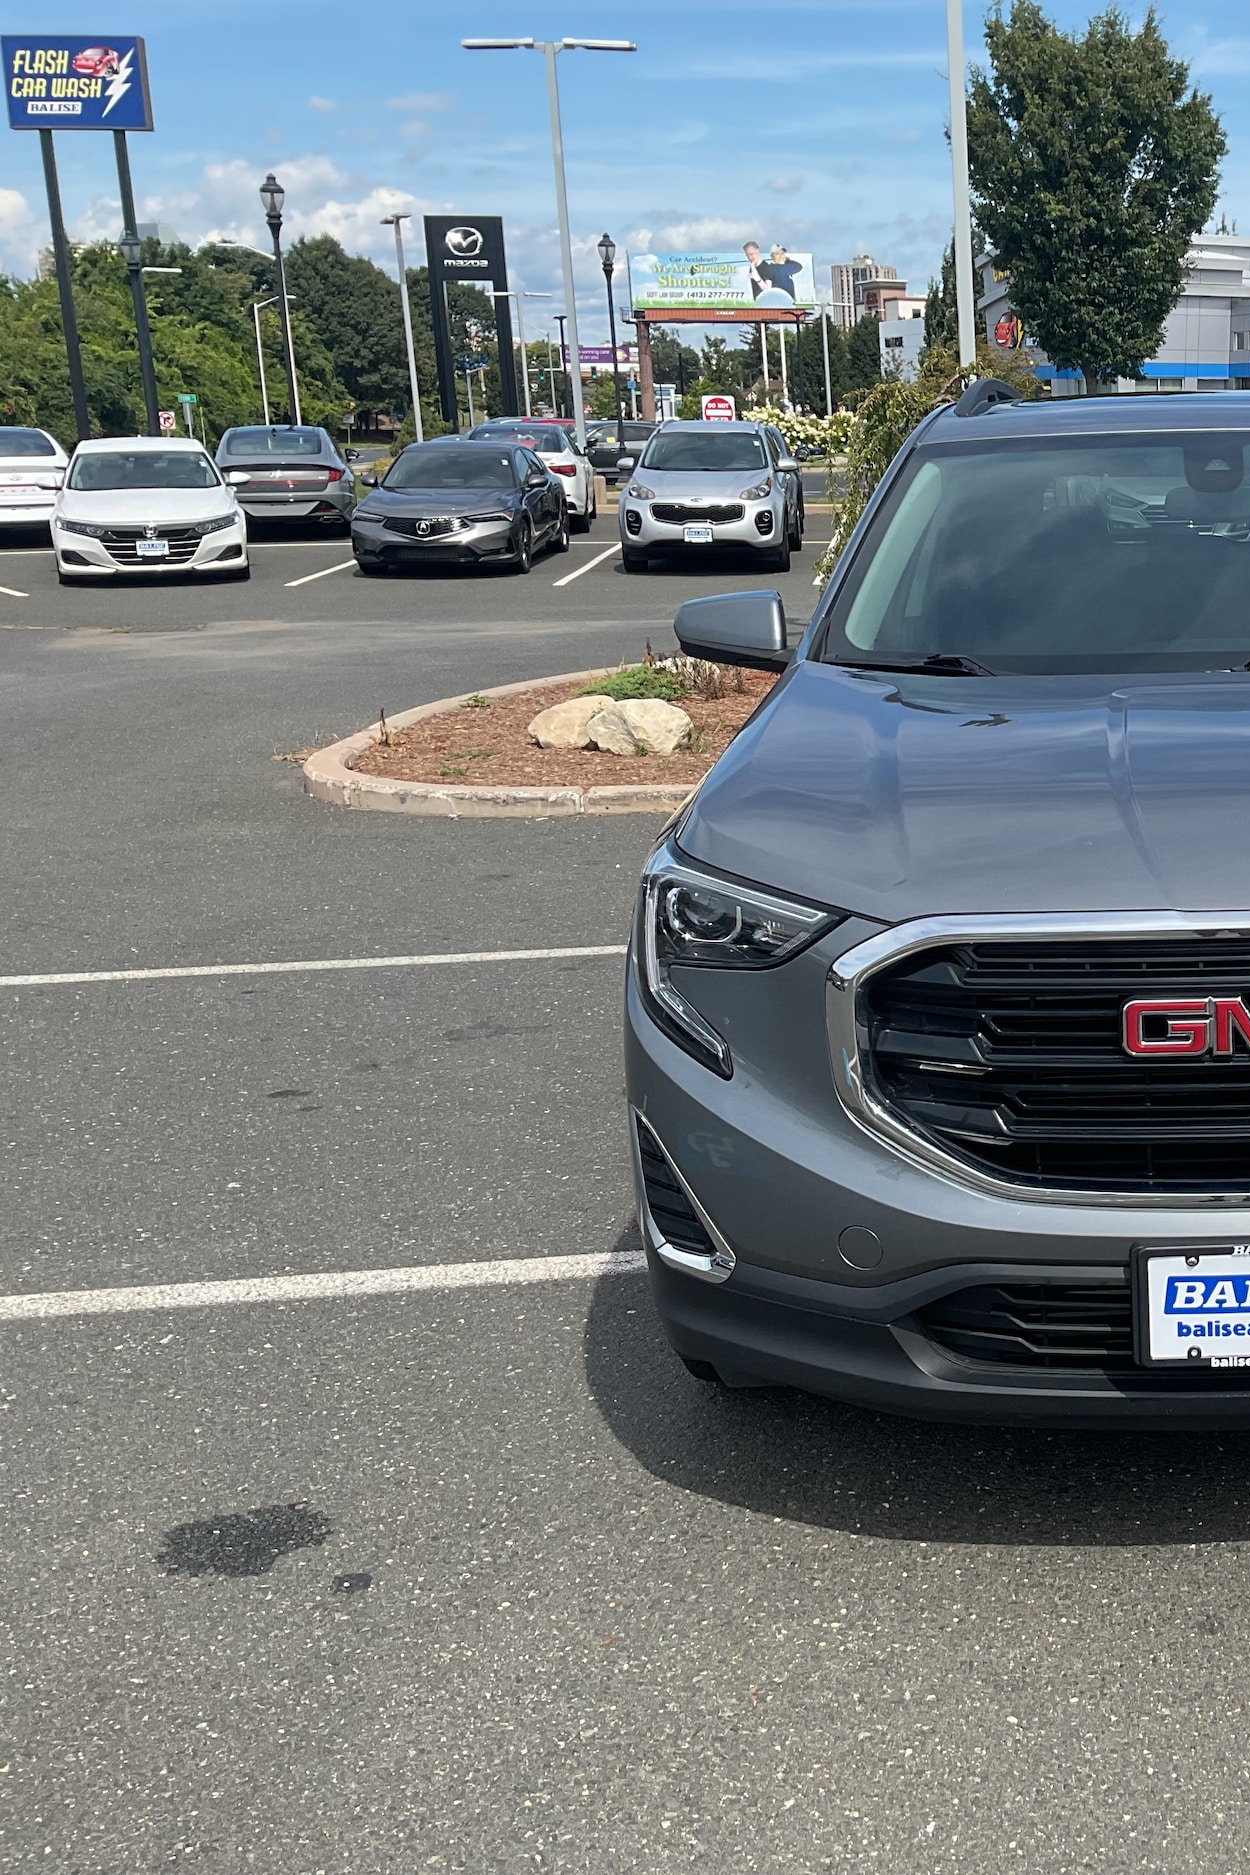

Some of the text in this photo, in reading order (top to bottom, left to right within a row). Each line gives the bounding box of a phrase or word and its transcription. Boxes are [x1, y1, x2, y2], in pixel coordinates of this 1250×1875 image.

[13, 50, 69, 75] FLASH
[11, 77, 103, 99] CAR WASH
[30, 103, 80, 113] BALISE
[652, 264, 736, 275] We Are Straight
[658, 274, 732, 288] Shooters!
[687, 291, 706, 299] (413)
